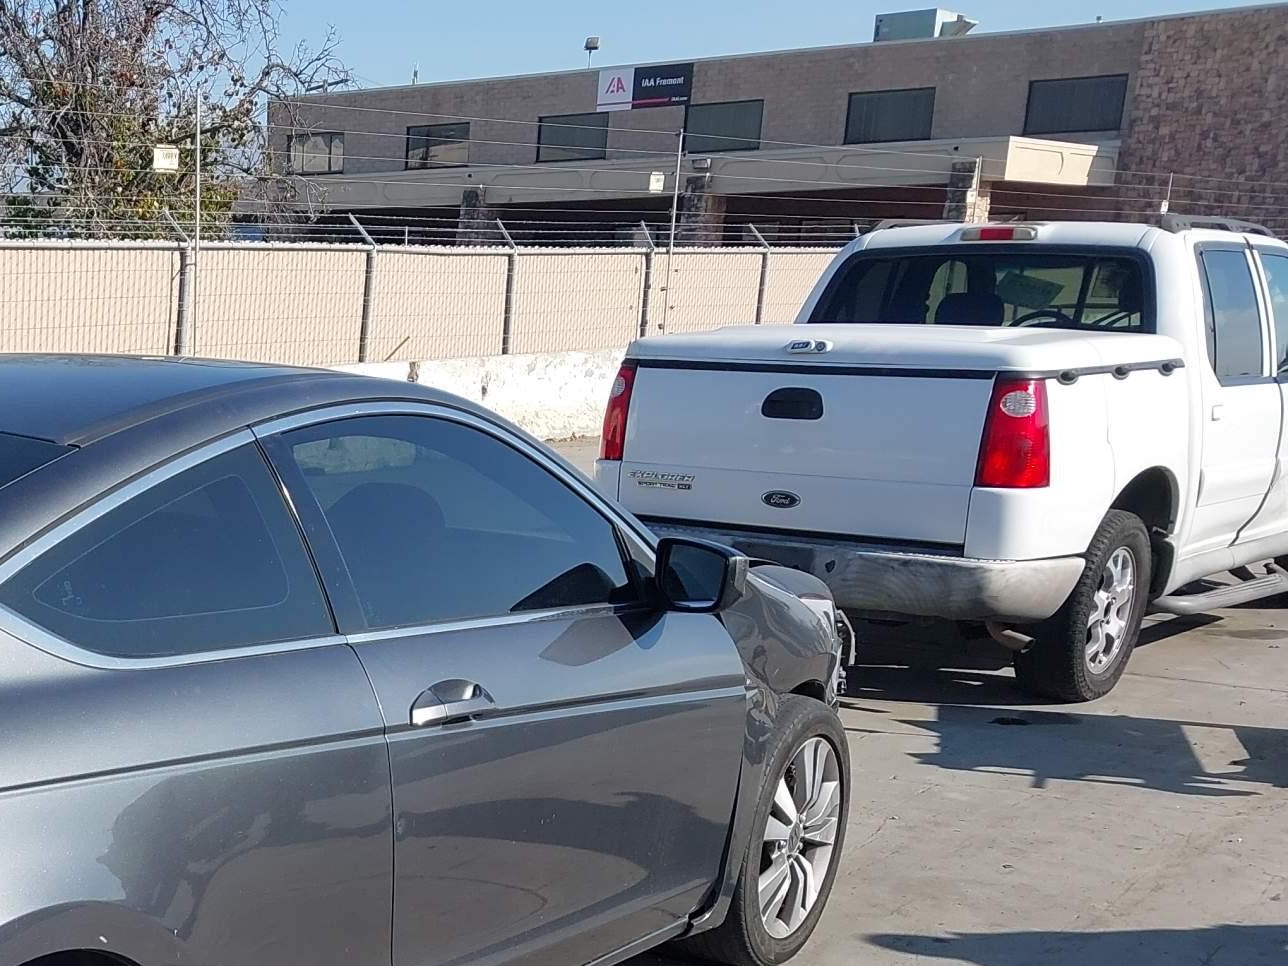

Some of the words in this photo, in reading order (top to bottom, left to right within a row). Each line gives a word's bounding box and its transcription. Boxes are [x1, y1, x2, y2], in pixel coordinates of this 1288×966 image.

[642, 77, 655, 87] IAA
[656, 76, 684, 86] Fremont
[770, 494, 790, 505] Ford
